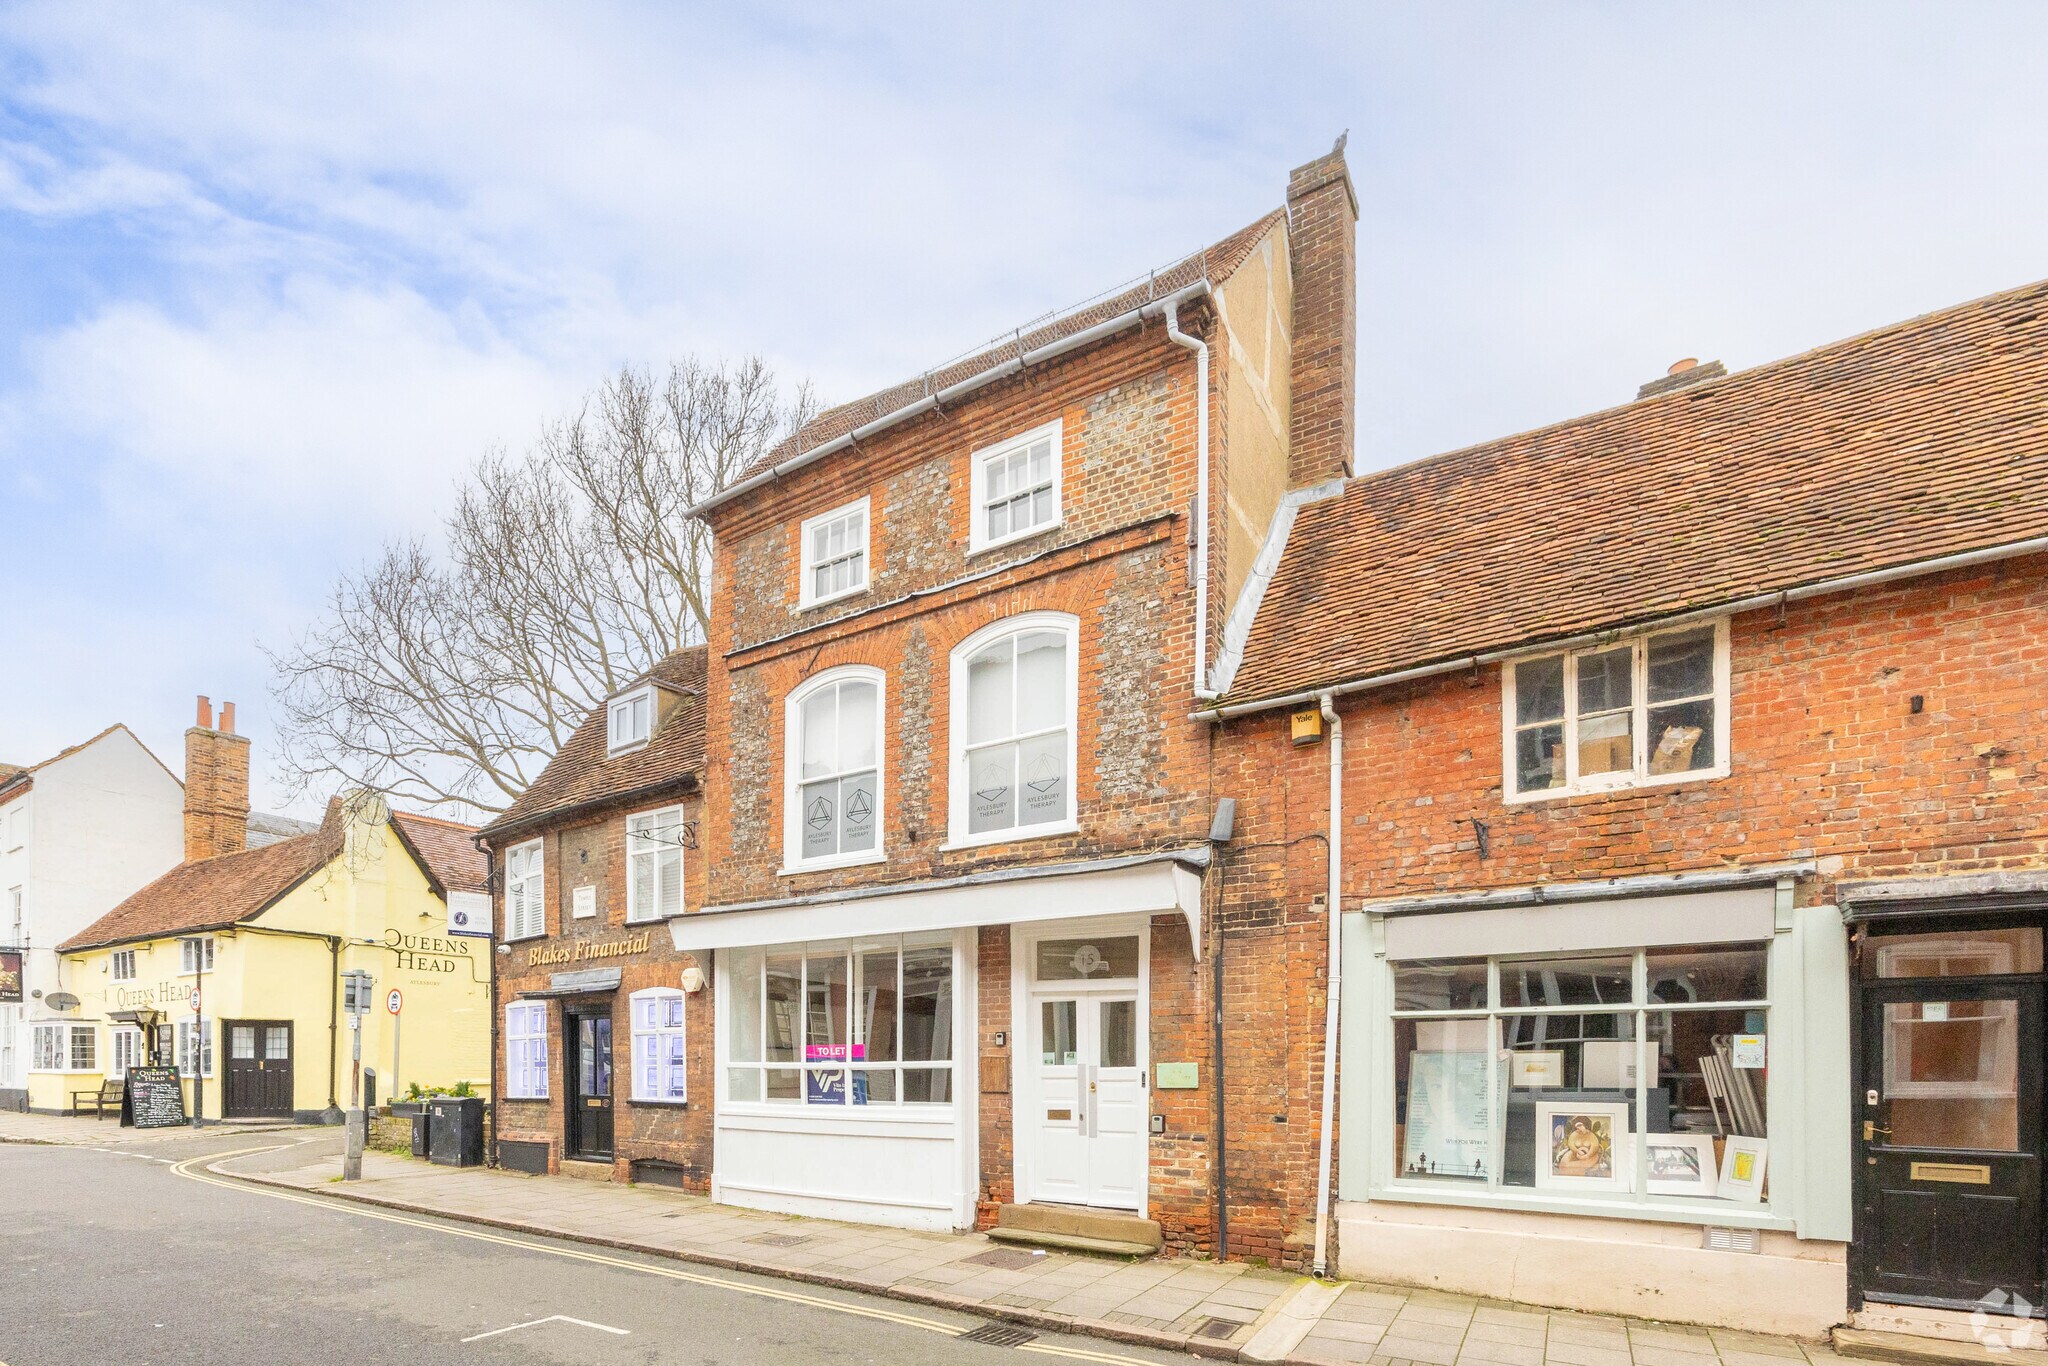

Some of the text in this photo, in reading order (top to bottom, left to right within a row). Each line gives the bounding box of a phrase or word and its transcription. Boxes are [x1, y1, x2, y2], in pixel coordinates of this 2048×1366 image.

[1296, 714, 1313, 723] Yale
[1026, 792, 1060, 803] AYLESBURY
[976, 802, 1008, 812] AYLESBURY
[1030, 800, 1057, 809] THERAPY
[979, 809, 1005, 818] THERAPY
[845, 824, 872, 833] AYLESBURY
[807, 831, 832, 839] AYLESBURY
[384, 928, 468, 954] QUEENS
[528, 932, 650, 967] Blakes Financial
[396, 951, 456, 973] HEAD
[117, 981, 192, 1011] QUEENS HEAD
[817, 1047, 846, 1056] TO LET
